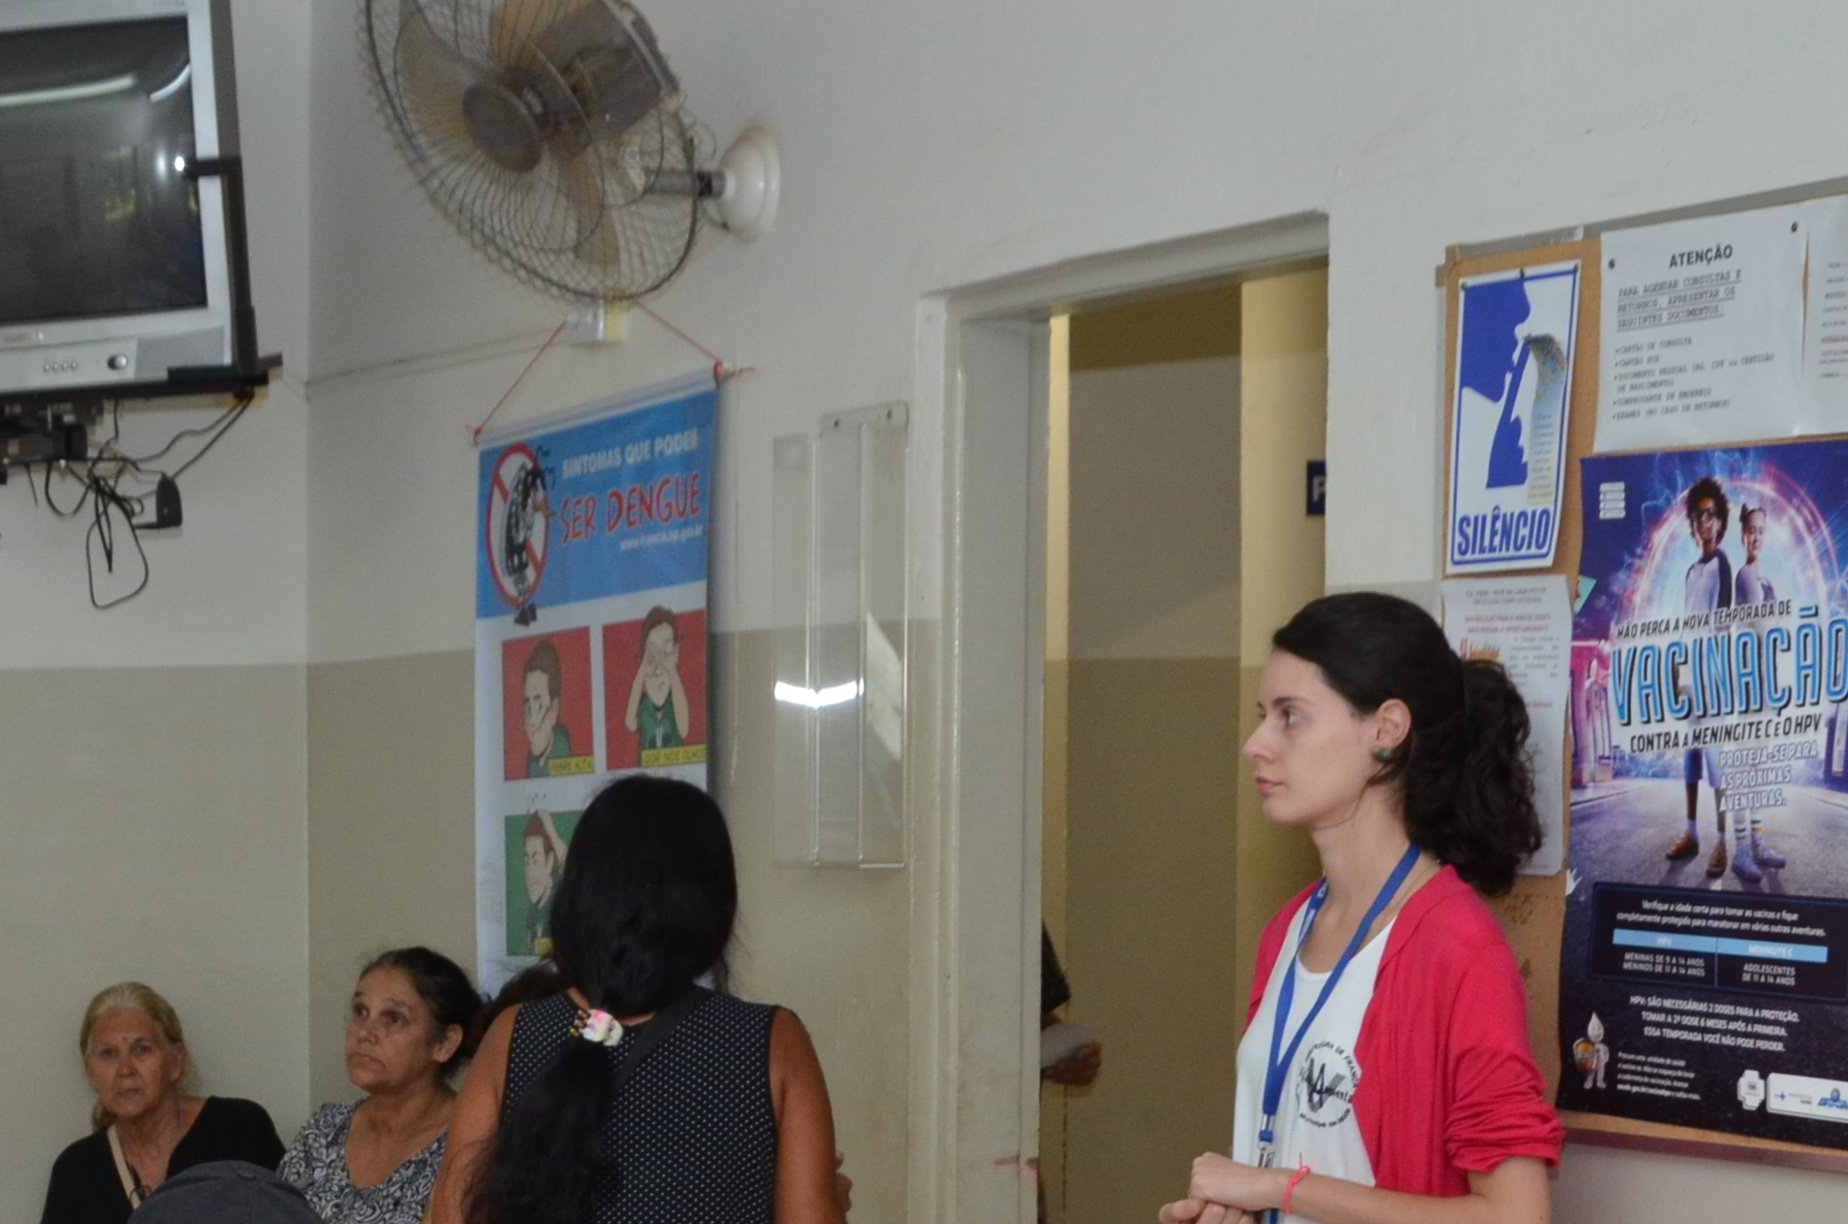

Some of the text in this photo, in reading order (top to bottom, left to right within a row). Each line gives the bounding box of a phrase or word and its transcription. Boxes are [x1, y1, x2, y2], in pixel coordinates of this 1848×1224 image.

[1669, 243, 1733, 269] ATENÇÃO
[1683, 271, 1731, 287] CONSULTAS
[625, 440, 651, 464] QUE
[561, 470, 700, 546] SER DENGUE
[1457, 504, 1551, 556] SILÊNCIO
[1617, 599, 1792, 640] NÃO PERCA A NOVA TEMPORADA DE
[1611, 605, 1848, 725] VACINAÇÃO
[1630, 730, 1679, 754] CONTRA
[1691, 719, 1762, 746] MENINGITE
[1765, 719, 1772, 738] C
[1782, 716, 1792, 736] O
[1794, 713, 1822, 734] HPV
[1719, 740, 1818, 768] PROTEJA-SE PARA
[1719, 788, 1787, 812] AVENTURAS.
[1654, 963, 1664, 973] DE
[1655, 955, 1664, 964] DE
[1743, 963, 1796, 976] ADOLESCENTES
[1776, 976, 1795, 986] ANOS
